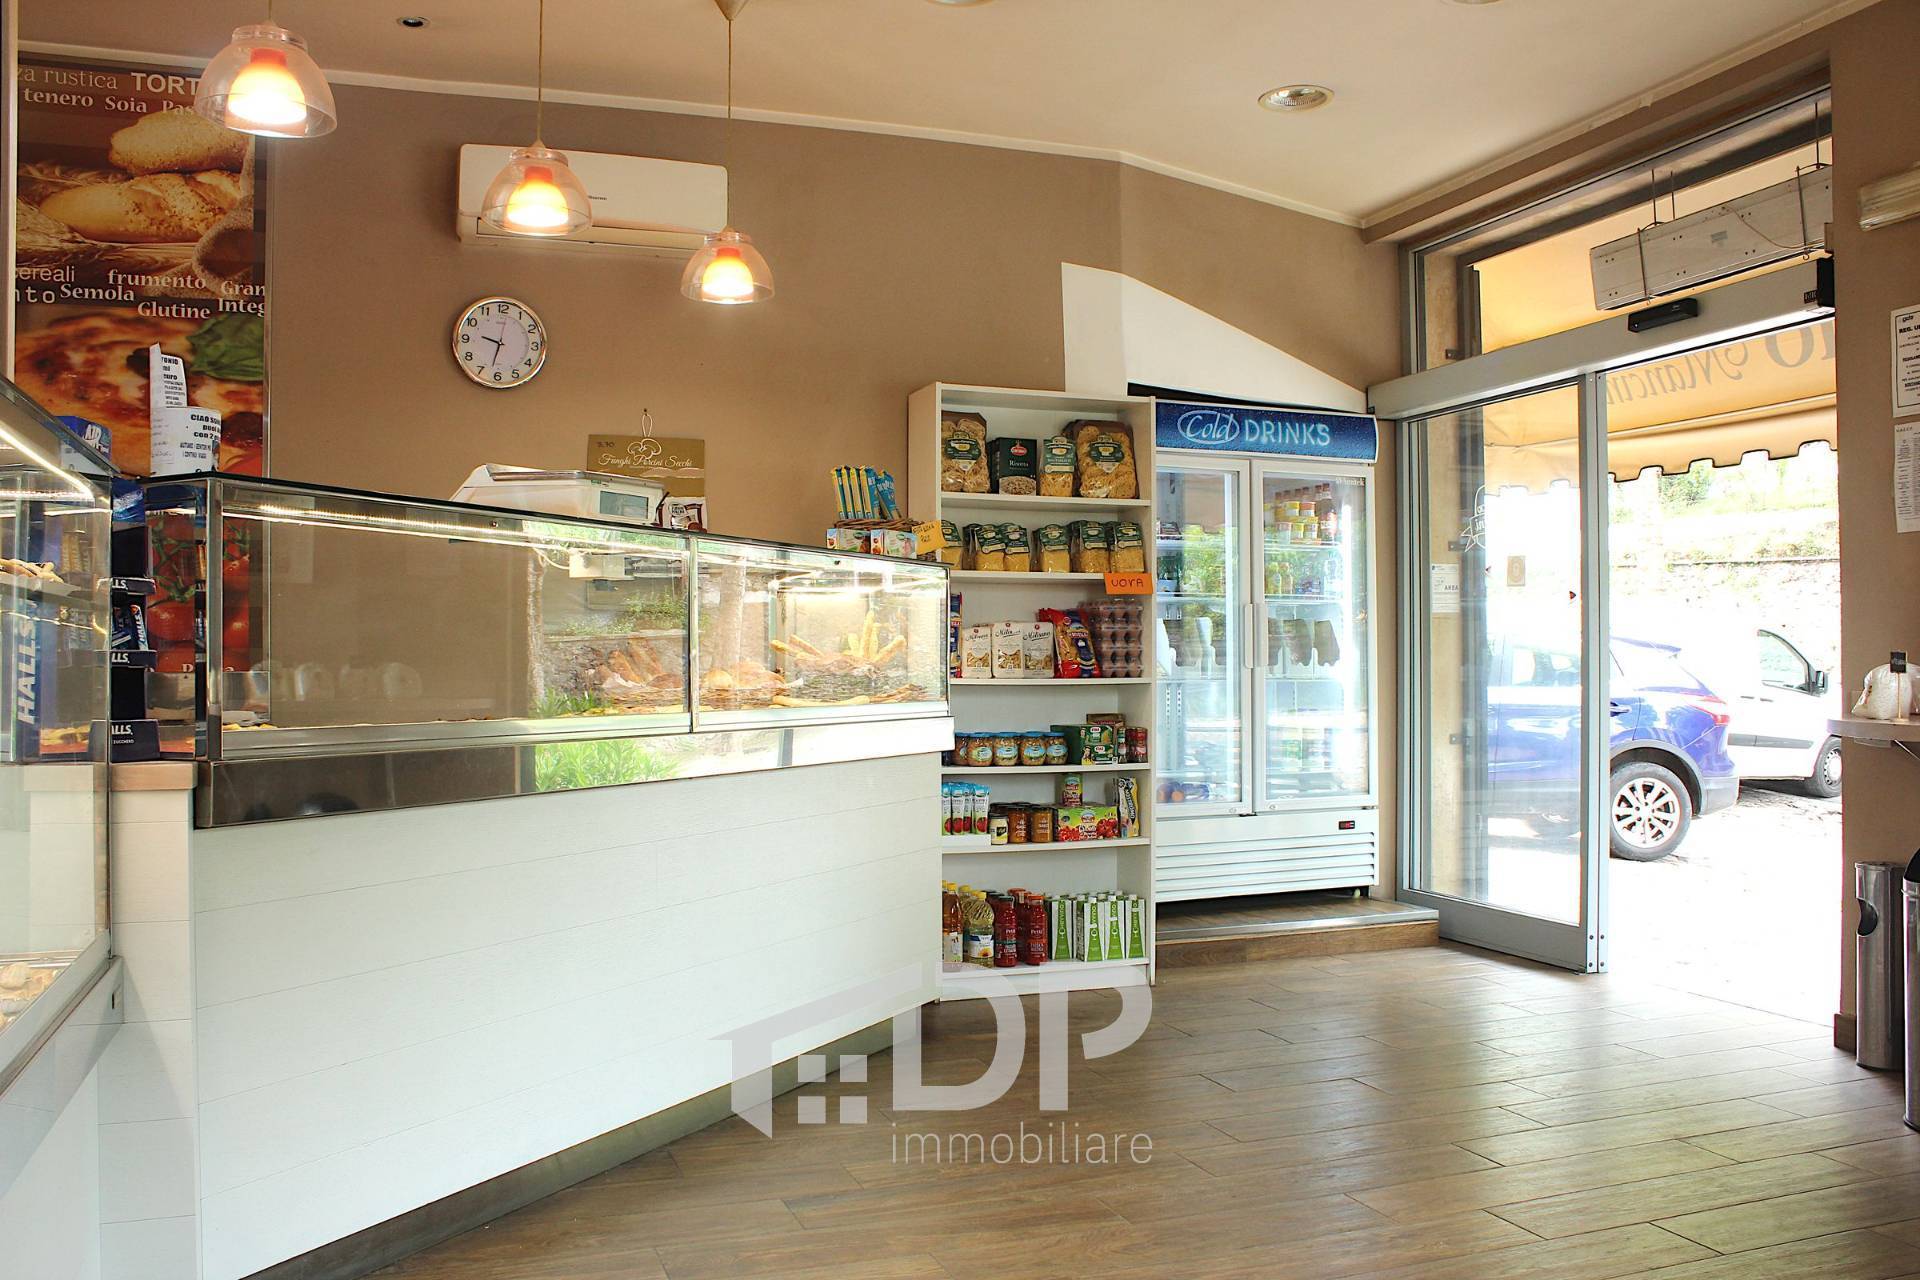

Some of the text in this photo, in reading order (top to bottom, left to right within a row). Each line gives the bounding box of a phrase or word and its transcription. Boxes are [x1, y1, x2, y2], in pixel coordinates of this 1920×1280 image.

[44, 69, 118, 90] rustica
[24, 87, 94, 108] tenero
[104, 96, 147, 113] Soia
[108, 268, 207, 289] frumento
[60, 283, 135, 301] Semola
[137, 301, 211, 319] Glutine
[481, 306, 490, 316] 11
[497, 303, 510, 314] 12
[466, 317, 478, 328] 10
[527, 324, 537, 334] 2
[461, 333, 470, 343] 9
[530, 341, 539, 351] 3
[464, 351, 473, 361] 8
[524, 358, 533, 367] 4
[476, 365, 485, 376] 7
[493, 371, 502, 381] 6
[511, 369, 520, 379] 5
[1186, 412, 1331, 446] Cold DRINKS
[599, 453, 692, 468] Funghi Porcini Secchi
[17, 618, 36, 725] HALLS
